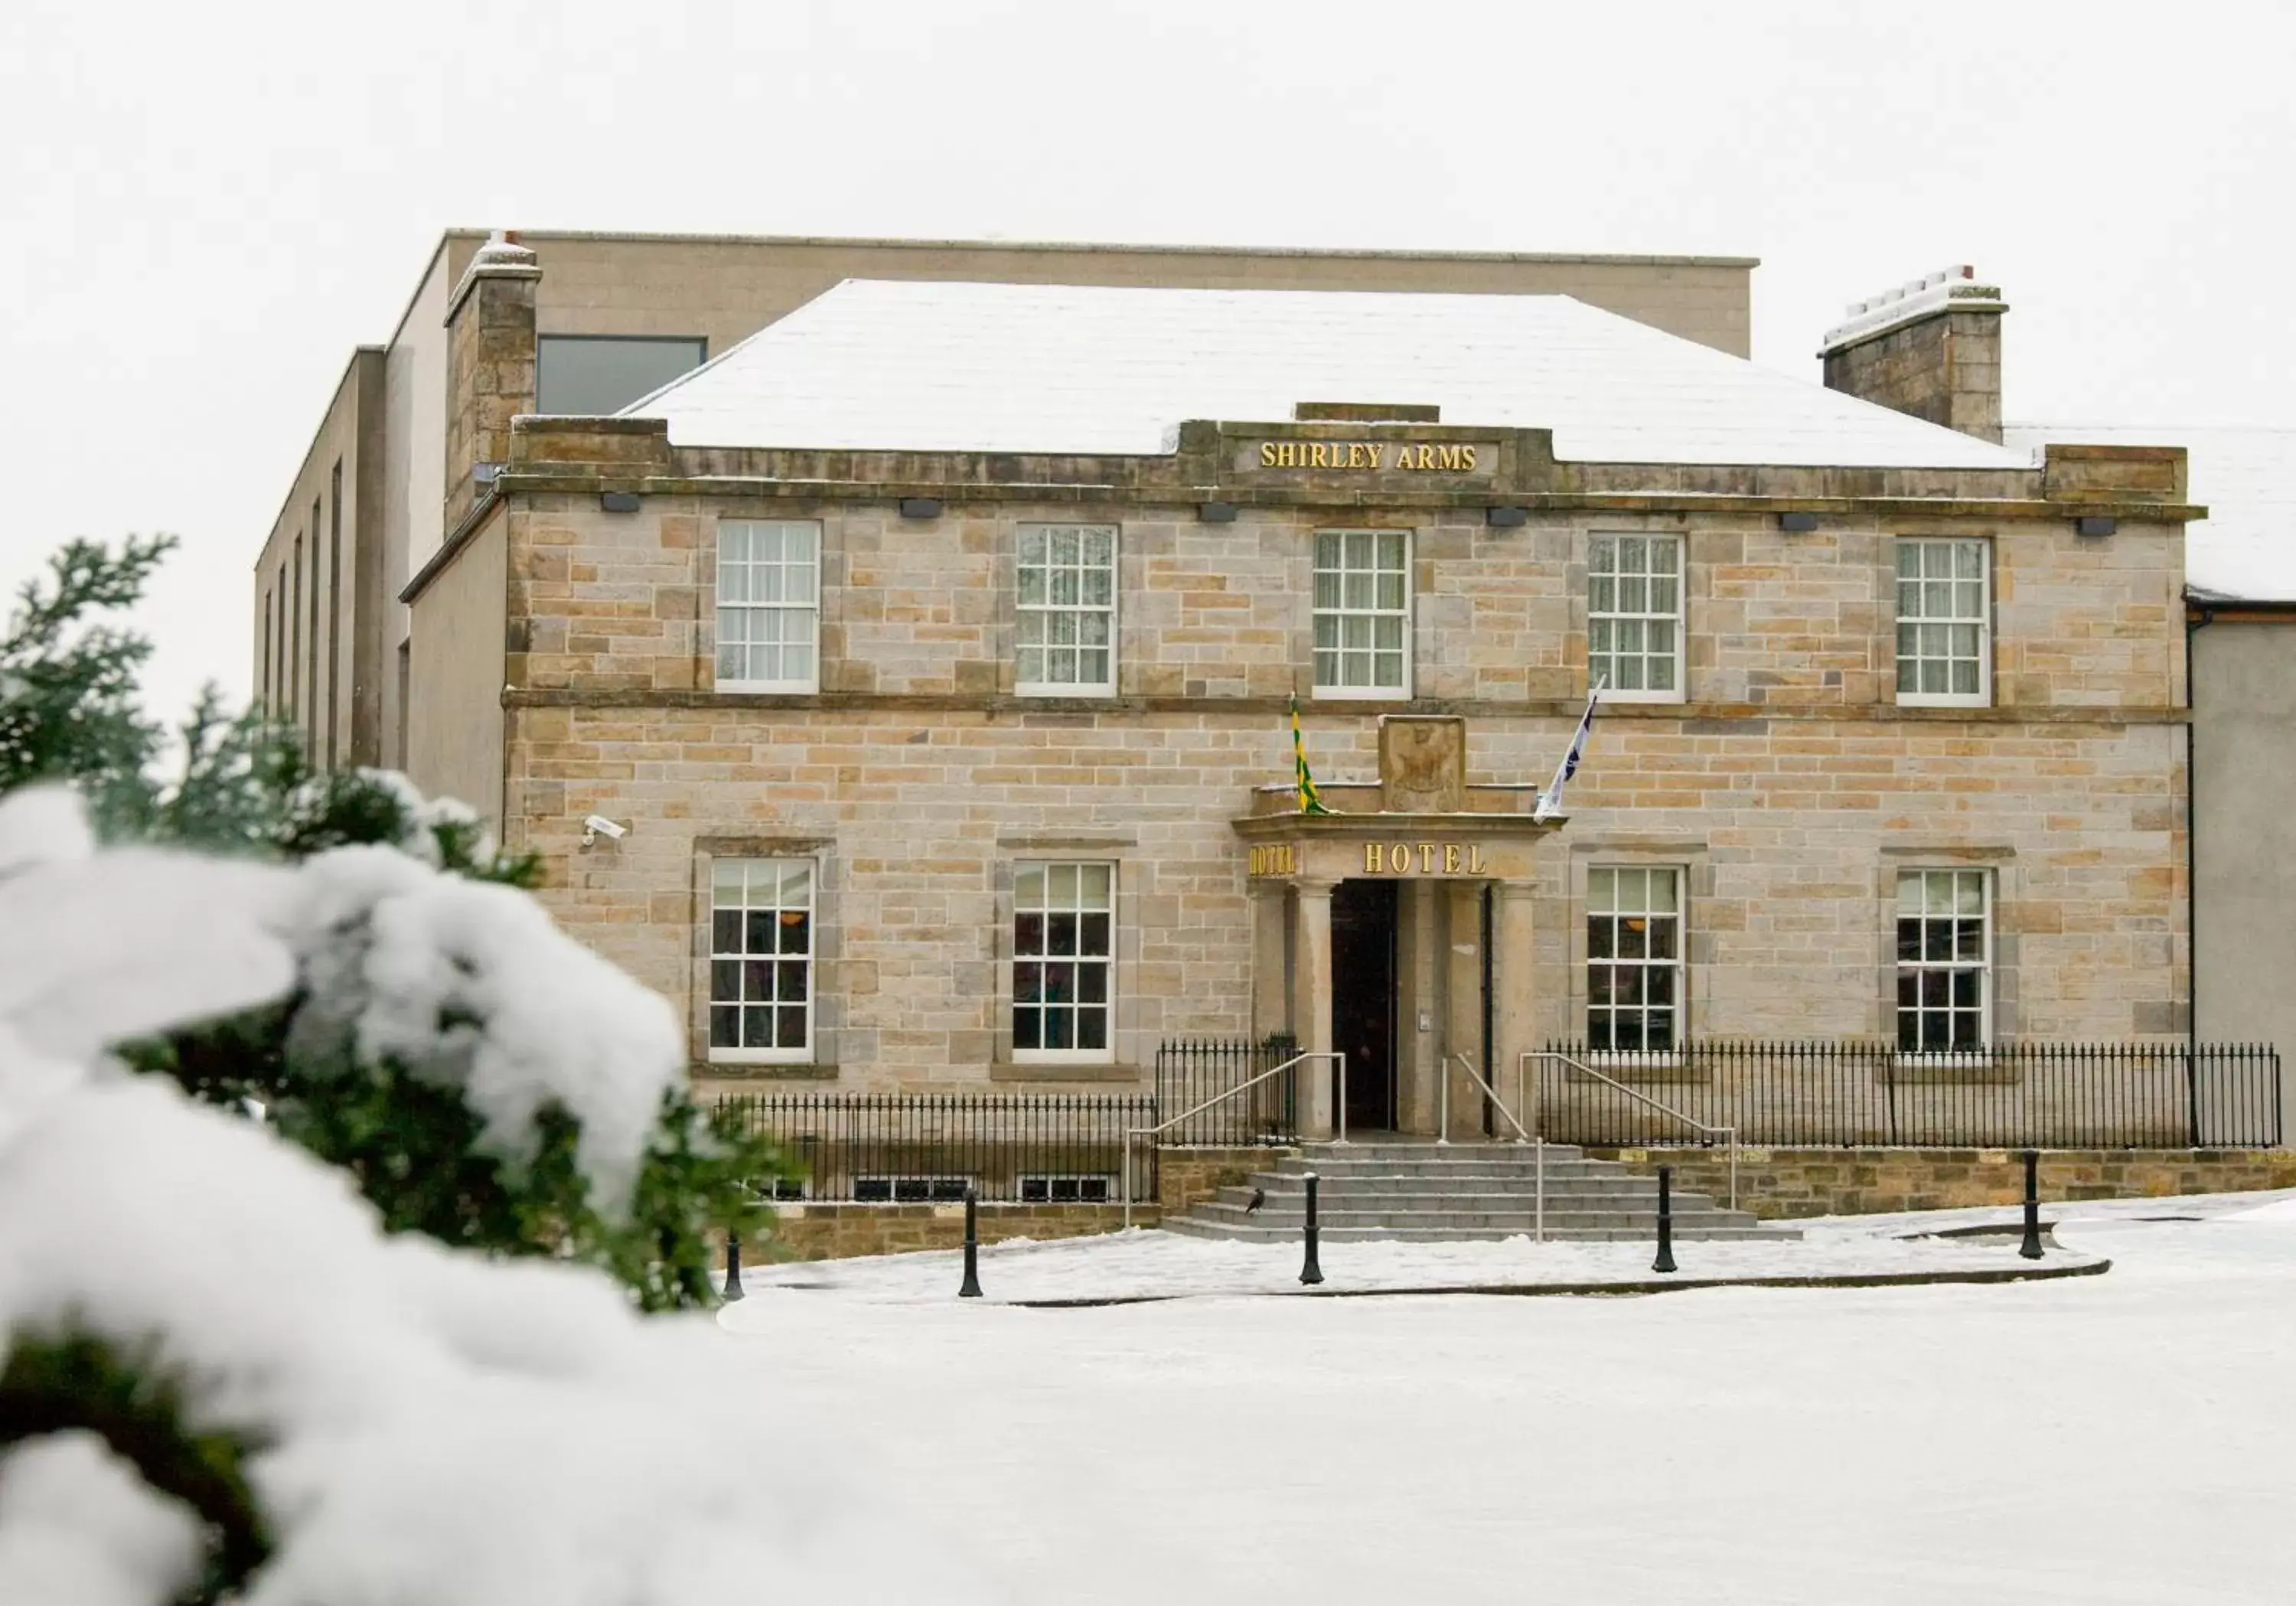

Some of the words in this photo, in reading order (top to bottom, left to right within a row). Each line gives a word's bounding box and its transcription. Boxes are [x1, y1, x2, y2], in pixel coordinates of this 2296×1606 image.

[1261, 442, 1384, 468] SHIRLEY
[1396, 444, 1476, 470] ARMS
[1249, 846, 1295, 874] HOTEL
[1364, 844, 1486, 874] HOTEL
